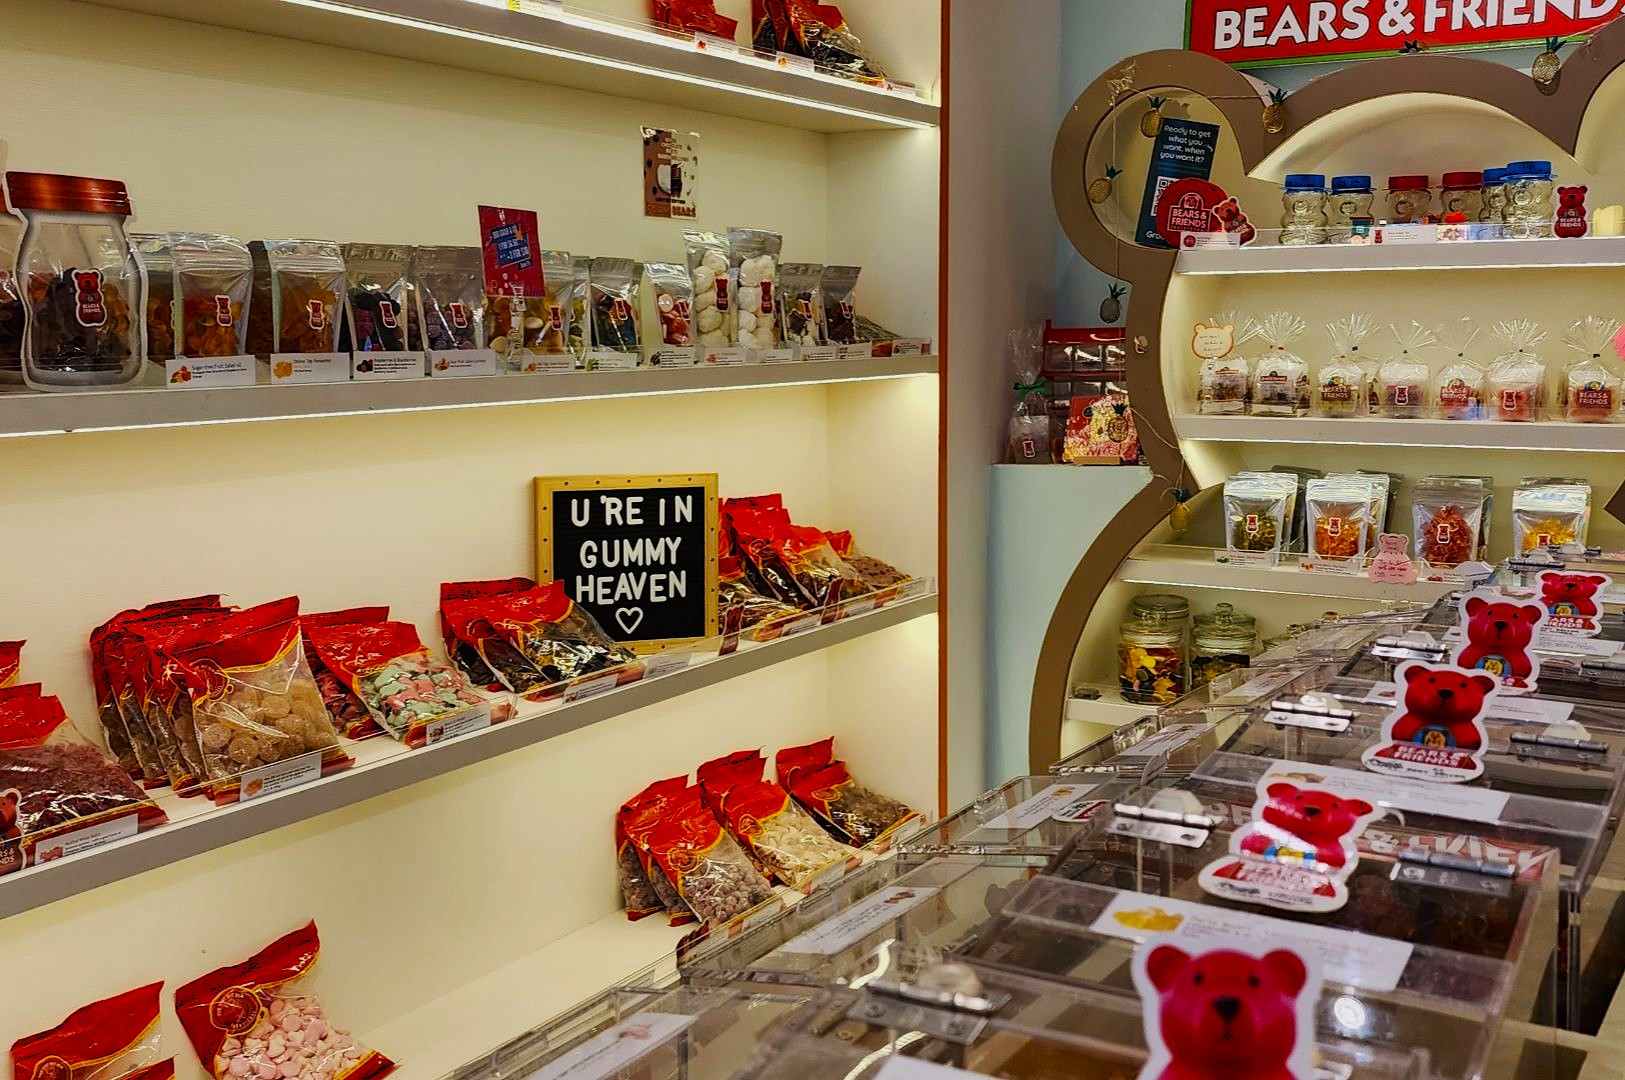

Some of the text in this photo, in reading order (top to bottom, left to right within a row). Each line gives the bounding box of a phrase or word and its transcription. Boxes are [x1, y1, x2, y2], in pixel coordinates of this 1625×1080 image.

[1213, 0, 1625, 50] BEARS & FRIEND
[1164, 125, 1188, 136] Ready
[1168, 136, 1187, 144] what
[1185, 147, 1205, 155] when
[1175, 154, 1194, 162] want
[1172, 209, 1199, 219] BEARS
[1171, 217, 1206, 228] FRIENDS
[579, 537, 682, 569] GUMMY
[575, 570, 687, 605] HEAVEN
